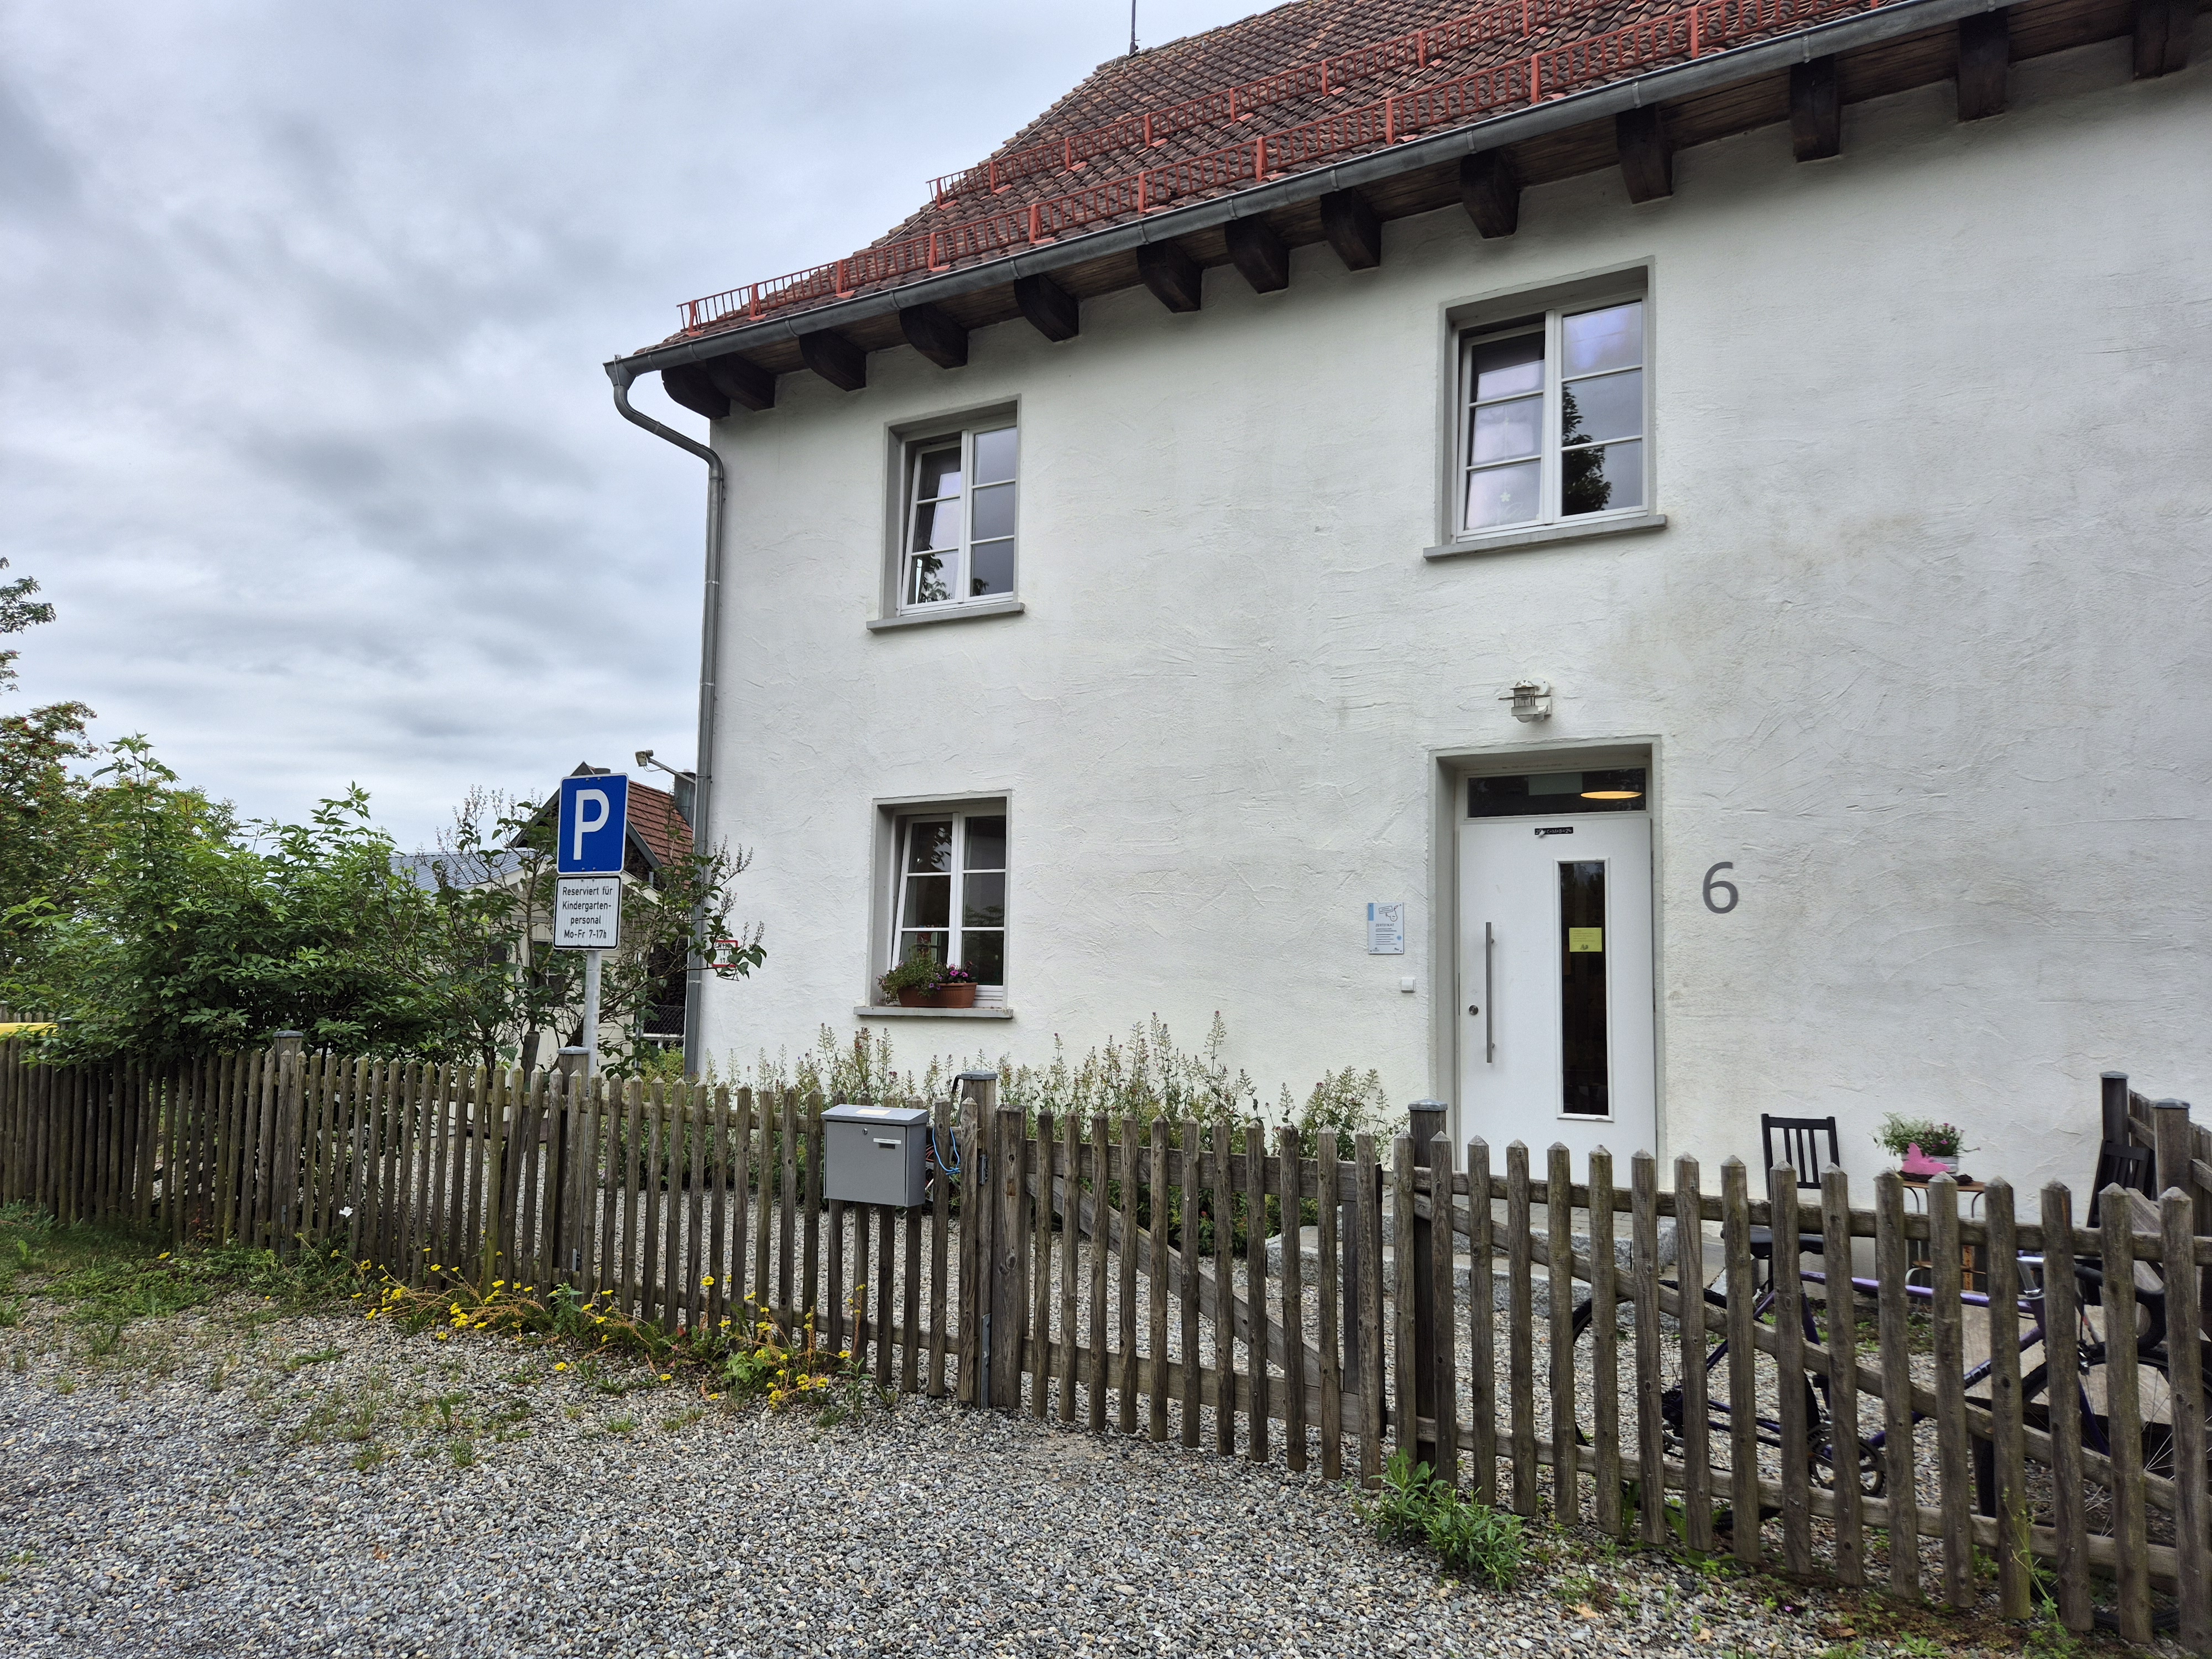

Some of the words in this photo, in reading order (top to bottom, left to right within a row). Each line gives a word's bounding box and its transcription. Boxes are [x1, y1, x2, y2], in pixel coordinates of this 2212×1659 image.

[573, 789, 609, 860] P
[562, 886, 599, 895] Reserviert
[602, 886, 613, 895] für
[1702, 862, 1738, 914] 6
[562, 901, 612, 912] Kindergarten-
[570, 915, 601, 926] personal
[564, 930, 586, 938] Mo-Fr
[589, 930, 607, 938] 7-17h
